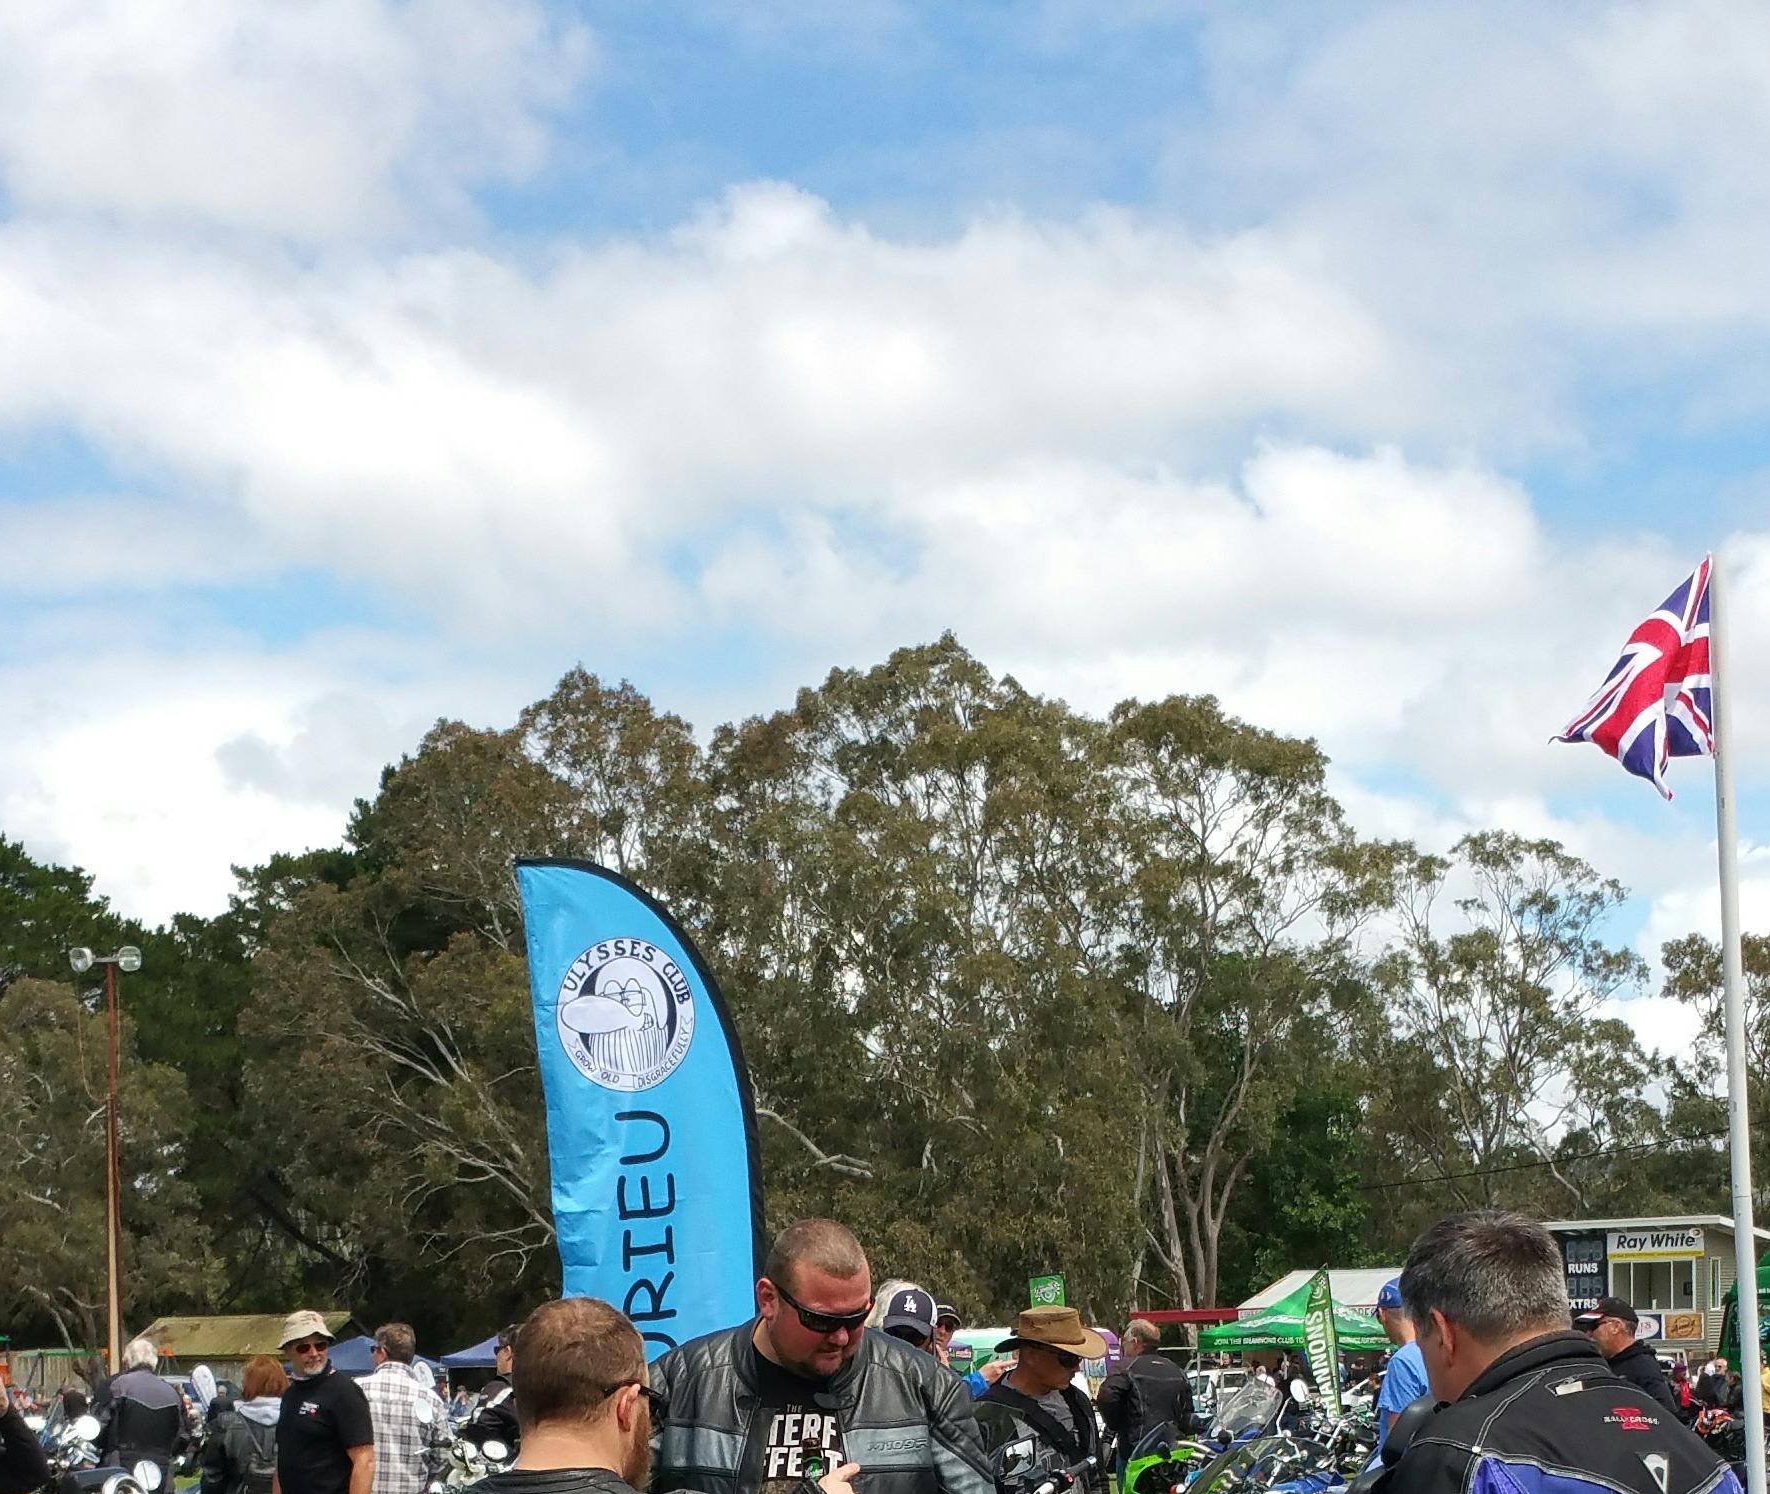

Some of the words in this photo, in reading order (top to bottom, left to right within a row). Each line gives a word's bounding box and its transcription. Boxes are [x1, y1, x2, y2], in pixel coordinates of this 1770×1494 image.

[563, 940, 656, 992] ULYSSES
[662, 962, 691, 1005] CLUB
[575, 1050, 596, 1073] GROW
[601, 1072, 620, 1084] OLD
[638, 1027, 689, 1088] DISGRACEFULLY
[1617, 1235, 1647, 1251] Ray
[1650, 1233, 1696, 1248] White
[1568, 1262, 1598, 1274] RUNS
[786, 1403, 802, 1412] THE
